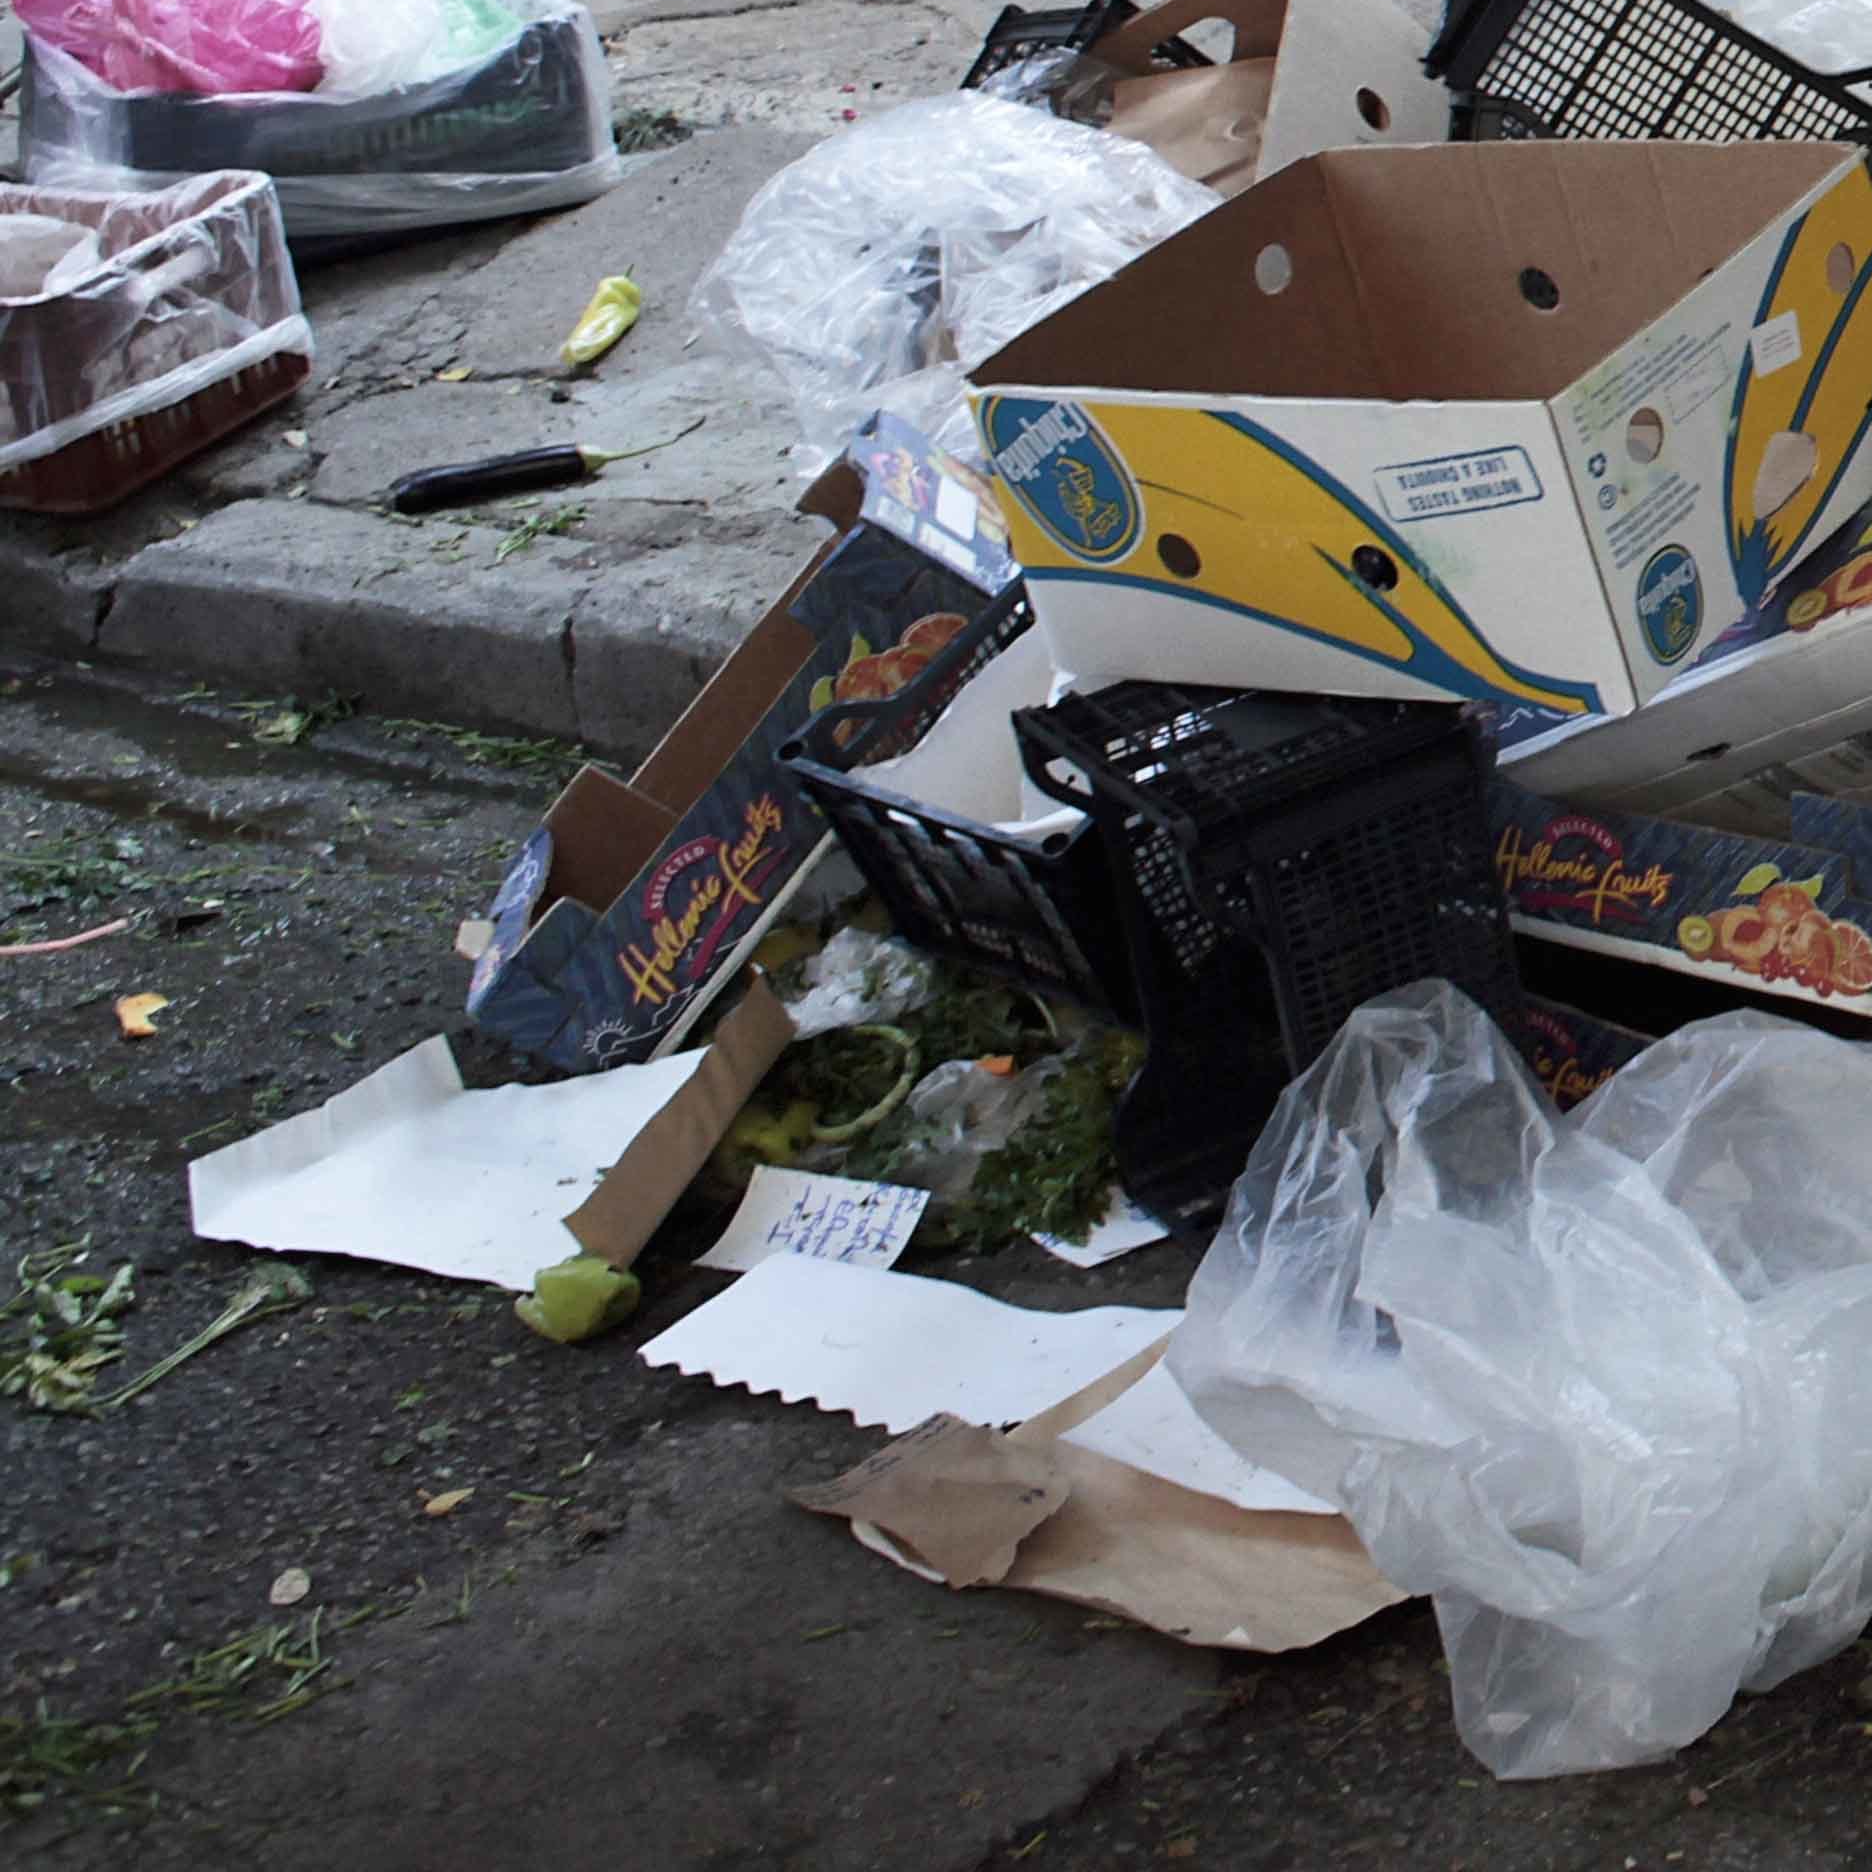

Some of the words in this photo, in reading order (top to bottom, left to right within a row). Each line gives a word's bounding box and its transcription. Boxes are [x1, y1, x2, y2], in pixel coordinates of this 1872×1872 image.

[996, 400, 1088, 482] Chiquita
[618, 874, 721, 1005] Hellenic
[718, 792, 783, 905] fruits
[650, 845, 705, 910] SELECTED
[1495, 822, 1598, 894] Hellenic
[1574, 858, 1676, 926] fruits
